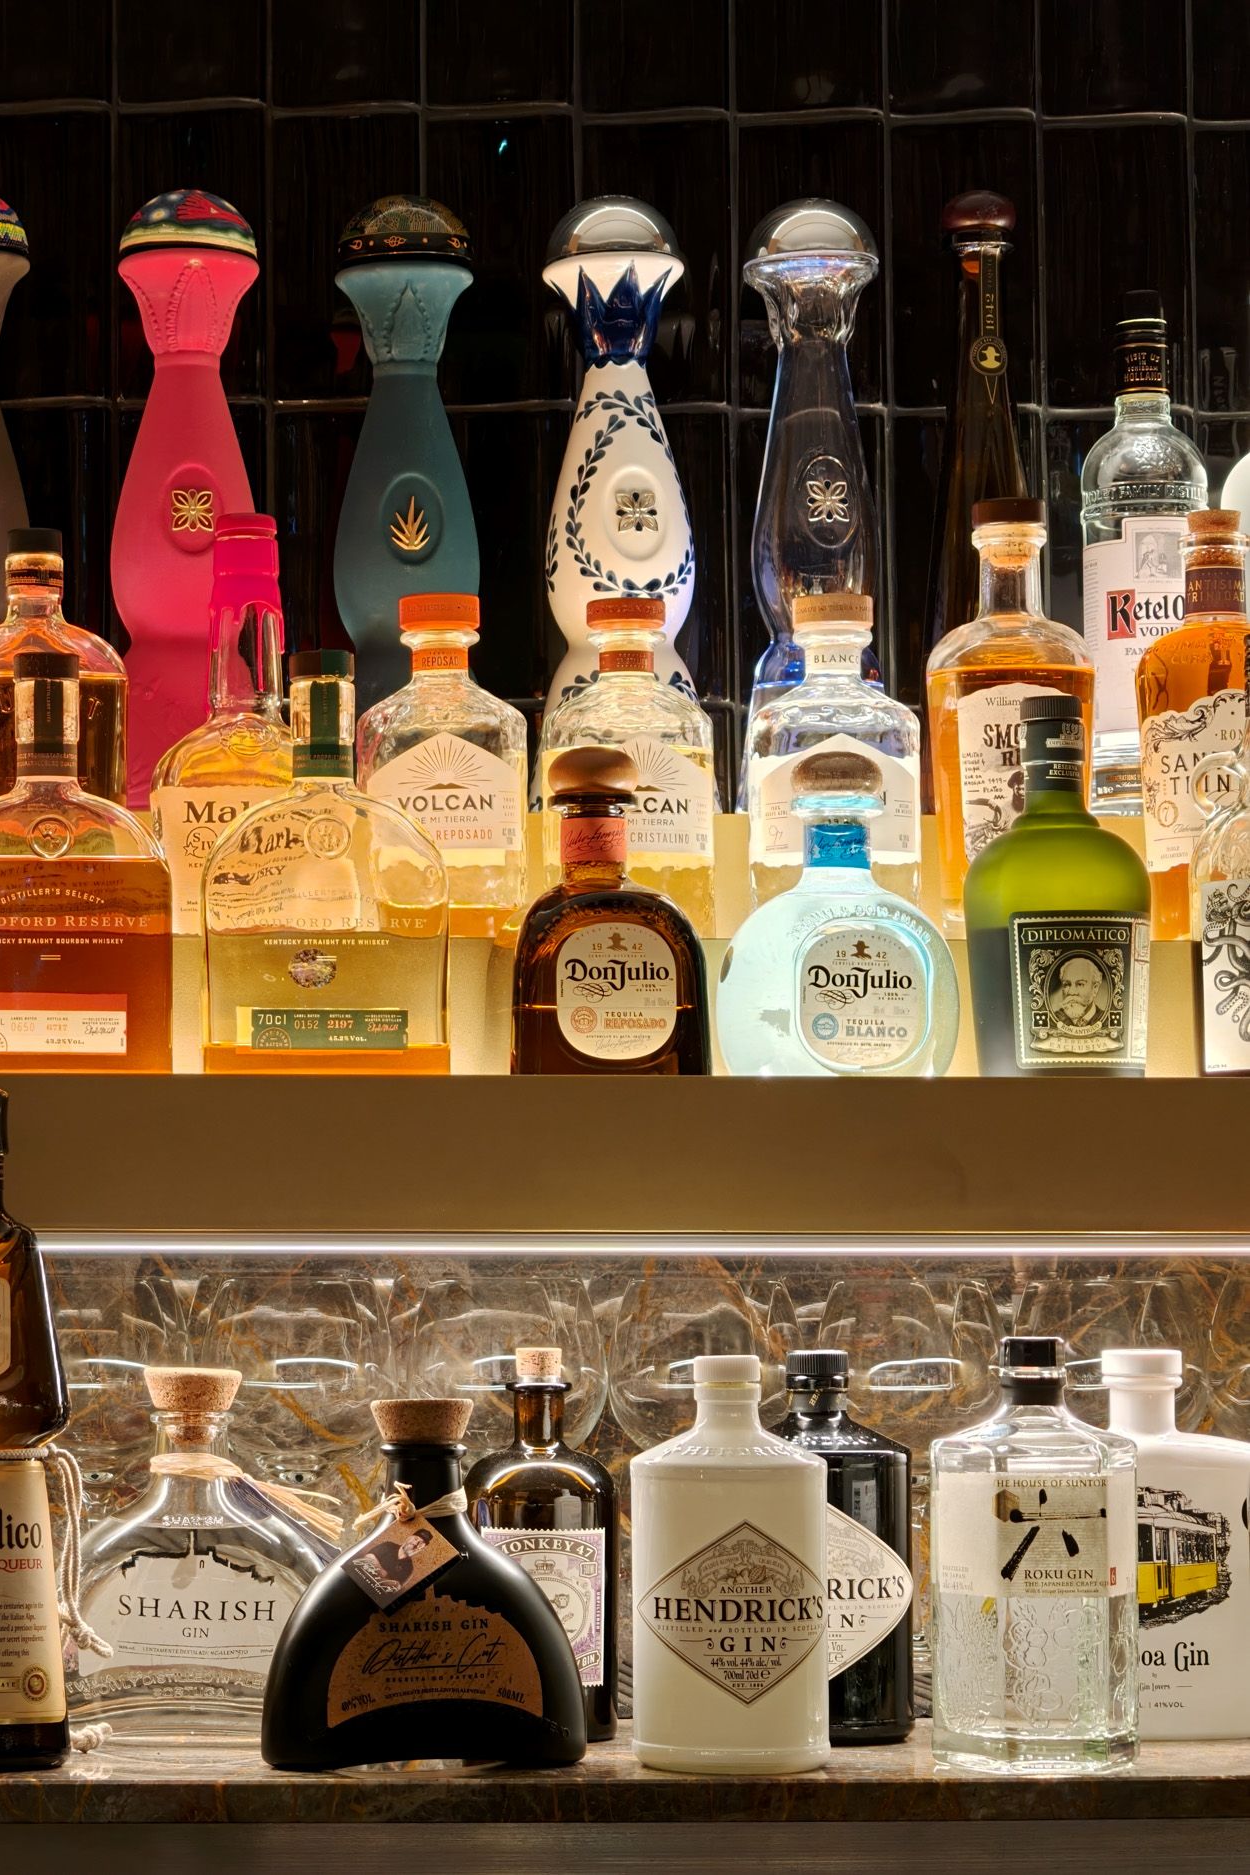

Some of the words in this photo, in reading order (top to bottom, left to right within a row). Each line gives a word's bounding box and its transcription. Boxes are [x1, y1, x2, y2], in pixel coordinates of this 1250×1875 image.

[1124, 372, 1162, 382] HOLLAND
[398, 794, 493, 812] VOLCAN
[642, 818, 675, 827] TIERRA
[436, 830, 493, 840] REPOSADO
[630, 831, 690, 845] CRISTALINO
[0, 888, 61, 905] DISTILLER'S
[64, 915, 148, 927] RESERVE
[231, 918, 333, 929] WOODFORD
[1028, 927, 1126, 941] DIPLOMÁTICO
[592, 943, 602, 951] 19
[632, 943, 643, 951] 42
[876, 951, 886, 959] 42
[257, 1014, 287, 1026] 70cl
[294, 1020, 319, 1030] 0152
[327, 1020, 354, 1029] 2197
[604, 1018, 667, 1029] REPOSADO
[845, 1026, 907, 1037] BLANCO
[994, 1479, 1011, 1488] HE
[1013, 1479, 1049, 1488] HOUSE
[1051, 1479, 1063, 1488] OF
[1066, 1479, 1107, 1488] SUNTOR
[576, 1543, 594, 1557] 47
[1024, 1569, 1063, 1579] ROKU
[1067, 1569, 1094, 1579] GIN
[720, 1585, 773, 1594] ANOTHER
[118, 1594, 276, 1622] SHARISH
[653, 1595, 823, 1623] HENDRICK'S
[379, 1621, 452, 1633] SHARISH
[461, 1619, 489, 1629] GIN
[182, 1627, 210, 1639] GIN
[720, 1636, 776, 1653] GIN
[582, 1654, 595, 1666] GIN
[1174, 1642, 1210, 1672] Gin
[723, 1669, 745, 1681] 700ml
